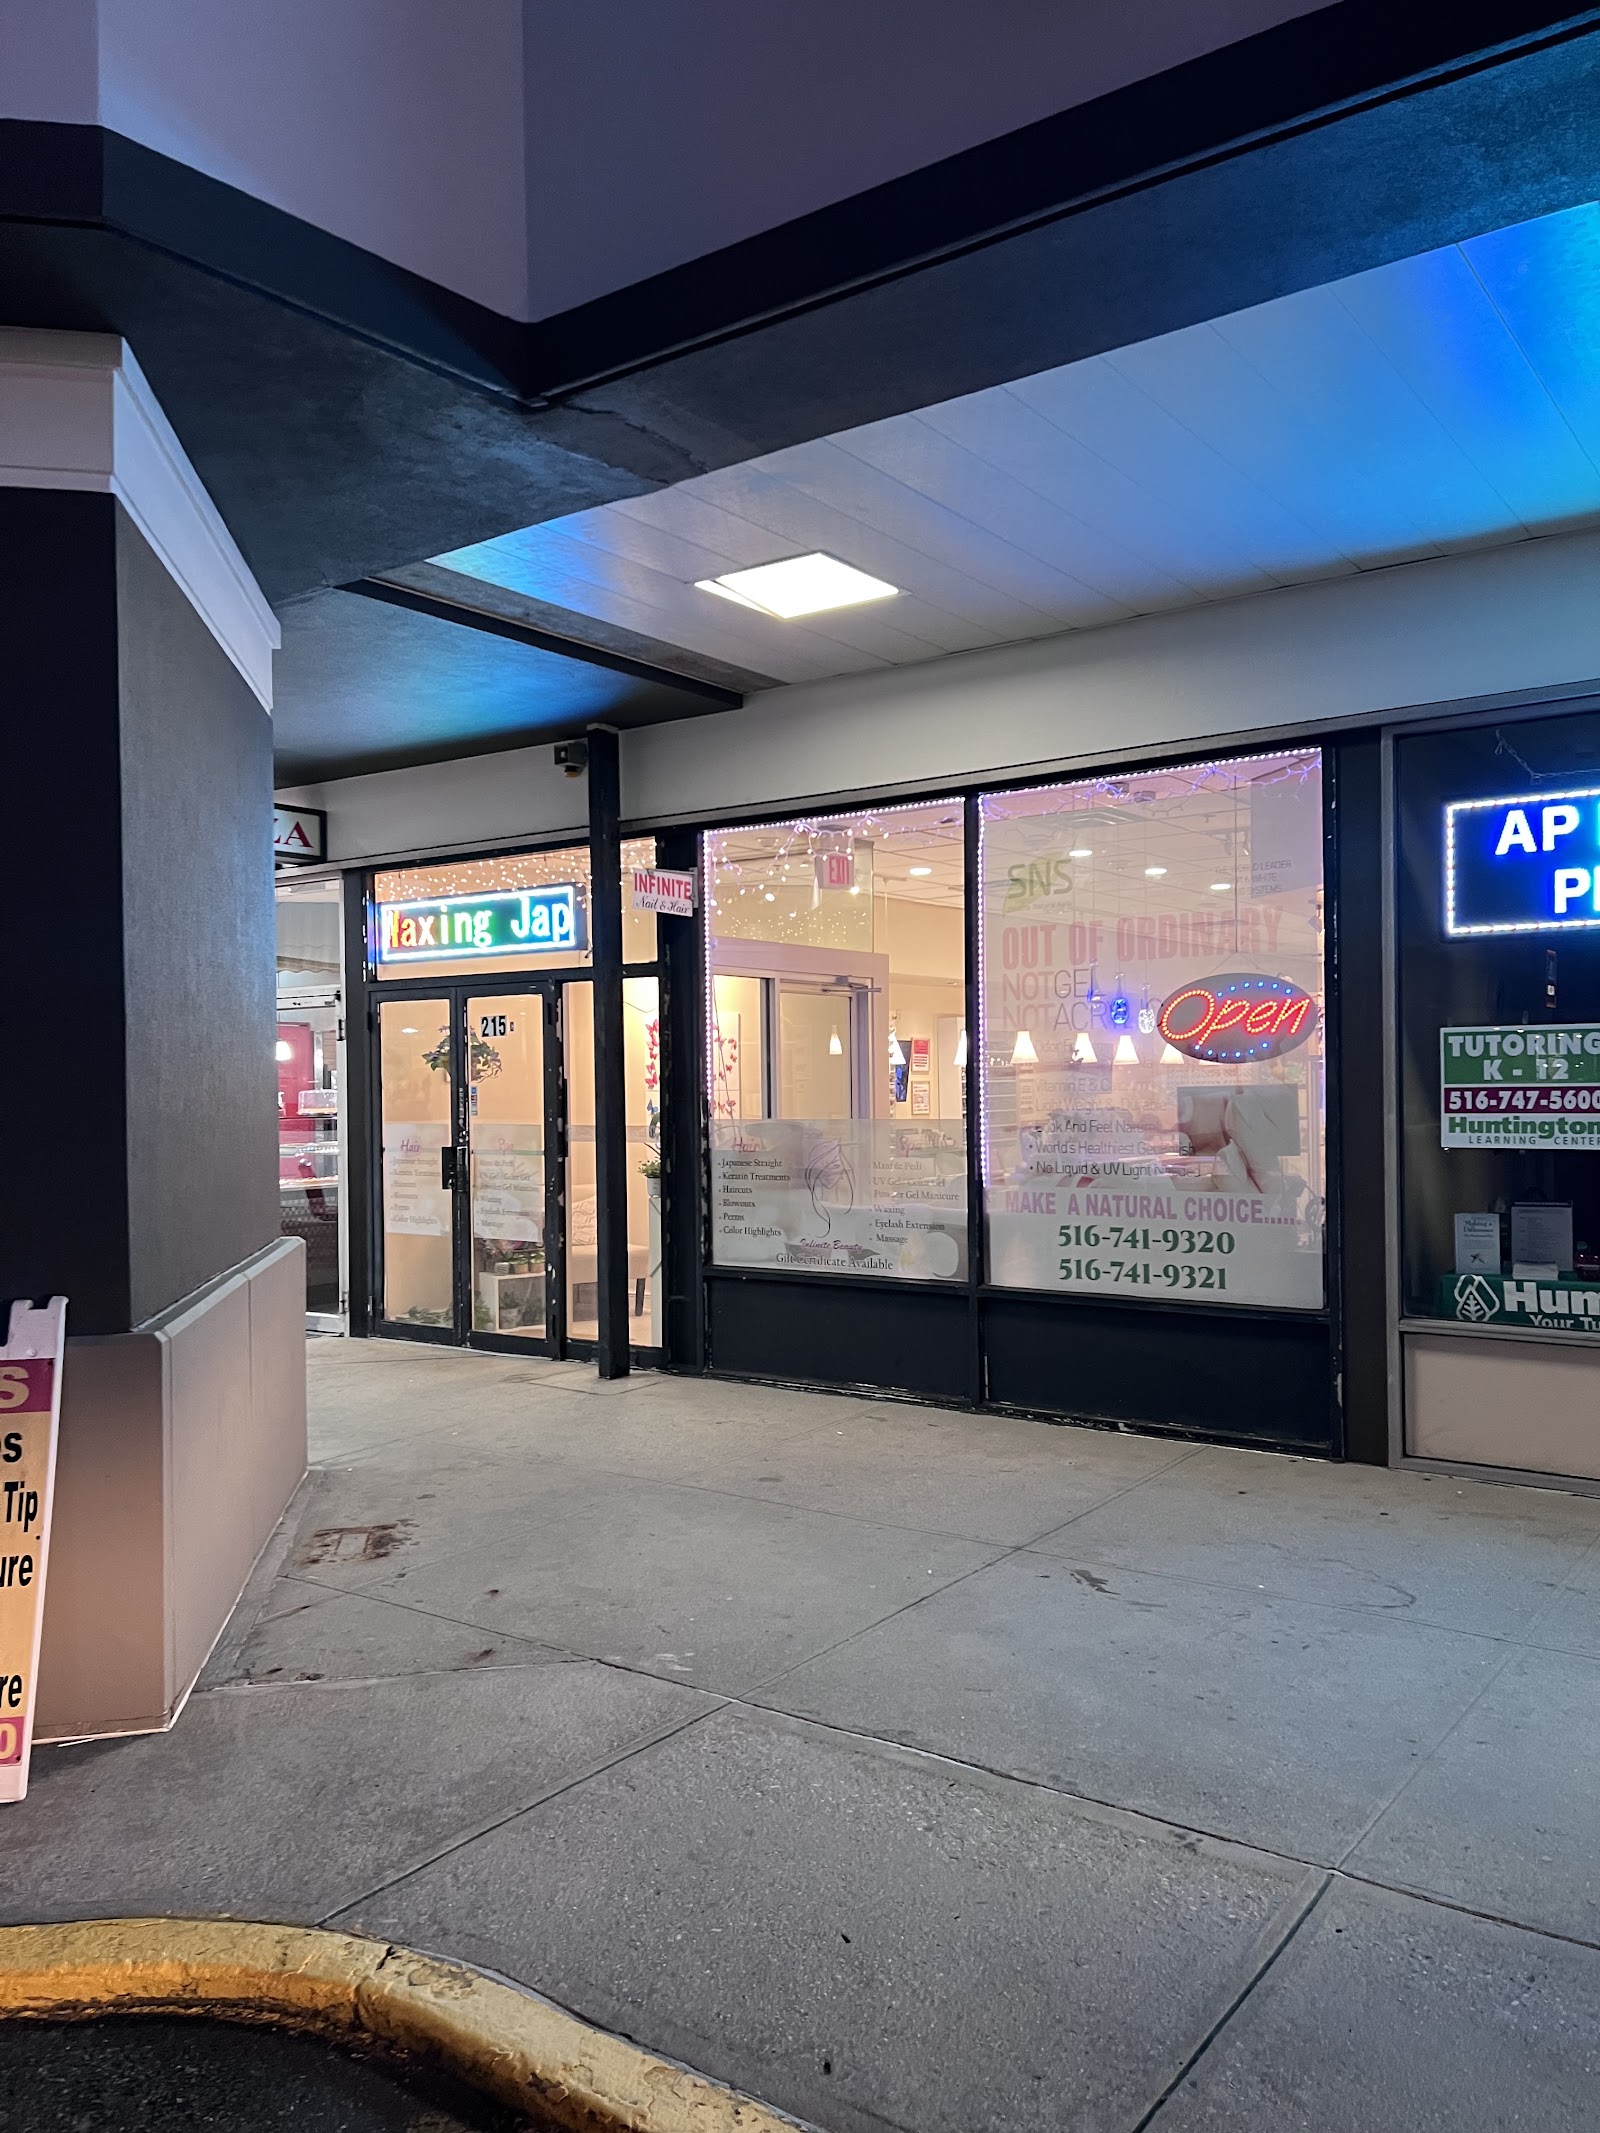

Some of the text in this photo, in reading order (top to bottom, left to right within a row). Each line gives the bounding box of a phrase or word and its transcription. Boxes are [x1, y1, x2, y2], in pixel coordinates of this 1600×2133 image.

[1495, 804, 1580, 856] AP
[634, 872, 692, 900] INFINITE
[1007, 858, 1073, 899] SNS
[635, 895, 690, 914] Nail & Hair
[510, 895, 573, 942] Jap
[1001, 905, 1284, 970] OUT OF ORDINARY
[481, 1015, 507, 1037] 215
[1161, 988, 1311, 1046] Open
[1448, 1032, 1600, 1057] TUTORING
[1483, 1059, 1504, 1081] K
[1536, 1058, 1569, 1080] 12
[1448, 1090, 1600, 1111] 516-747-5600
[1065, 1119, 1087, 1133] And
[1089, 1119, 1113, 1133] Feel
[1448, 1115, 1600, 1140] Huntington
[1036, 1140, 1076, 1155] World's
[1079, 1140, 1134, 1155] Healthiest
[1469, 1135, 1600, 1146] LEARNING CENTER
[720, 1158, 782, 1169] Japanese Straight
[1036, 1160, 1053, 1175] No
[1055, 1160, 1088, 1178] Liquid
[1090, 1161, 1100, 1176] &
[1103, 1161, 1120, 1176] UV
[1122, 1161, 1152, 1180] Light
[750, 1172, 792, 1182] Treatments
[905, 1190, 919, 1200] Gel
[1005, 1191, 1057, 1215] MAKE
[1067, 1192, 1080, 1216] A
[1085, 1192, 1178, 1221] NATURAL
[723, 1225, 782, 1238] Color Highlights
[874, 1218, 904, 1230] Eyelash
[1057, 1224, 1236, 1256] 516-741-9320
[776, 1252, 894, 1270] Gift Certificate Available
[1058, 1257, 1229, 1290] 516-741-9321
[1529, 1314, 1575, 1329] Your
[3, 1480, 39, 1533] Tip
